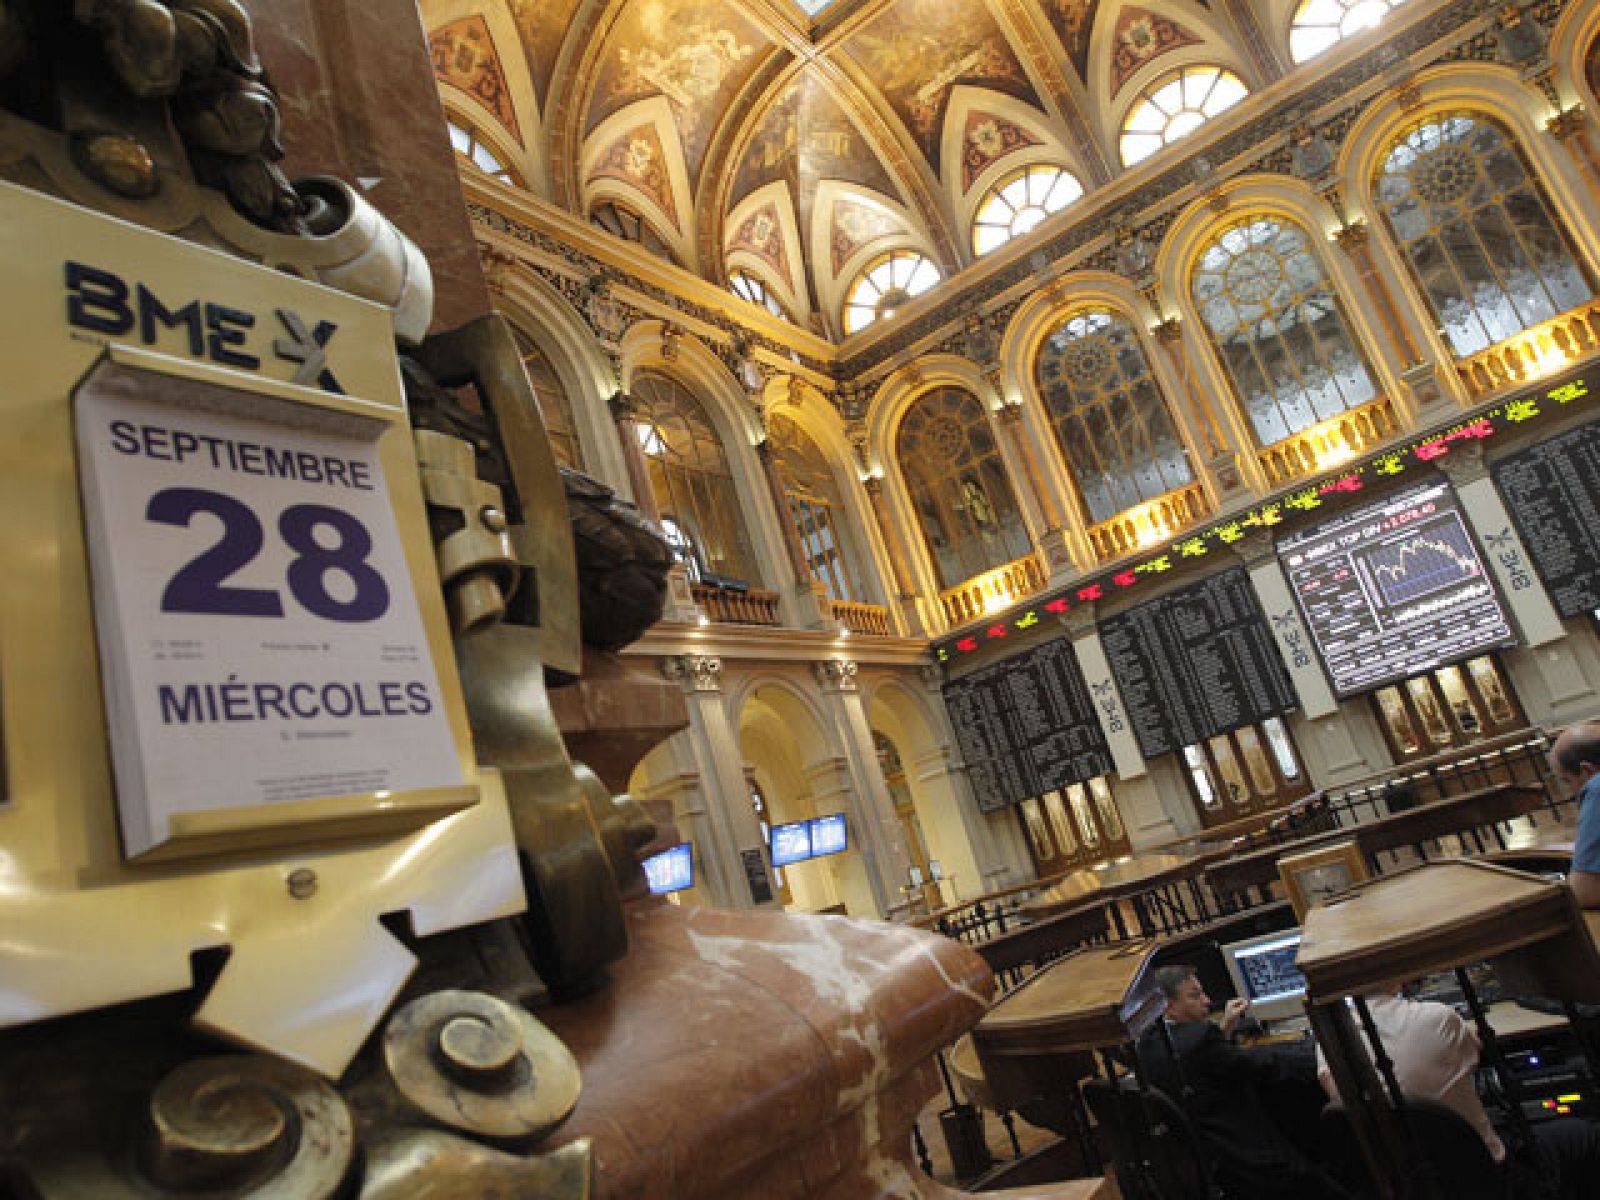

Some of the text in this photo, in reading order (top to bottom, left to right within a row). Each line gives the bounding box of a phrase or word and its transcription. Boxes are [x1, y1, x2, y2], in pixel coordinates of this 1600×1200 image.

[65, 260, 260, 370] BME
[110, 420, 374, 490] SEPTIEMBRE
[145, 487, 391, 623] 28
[158, 673, 433, 724] MIÉRCOLES
